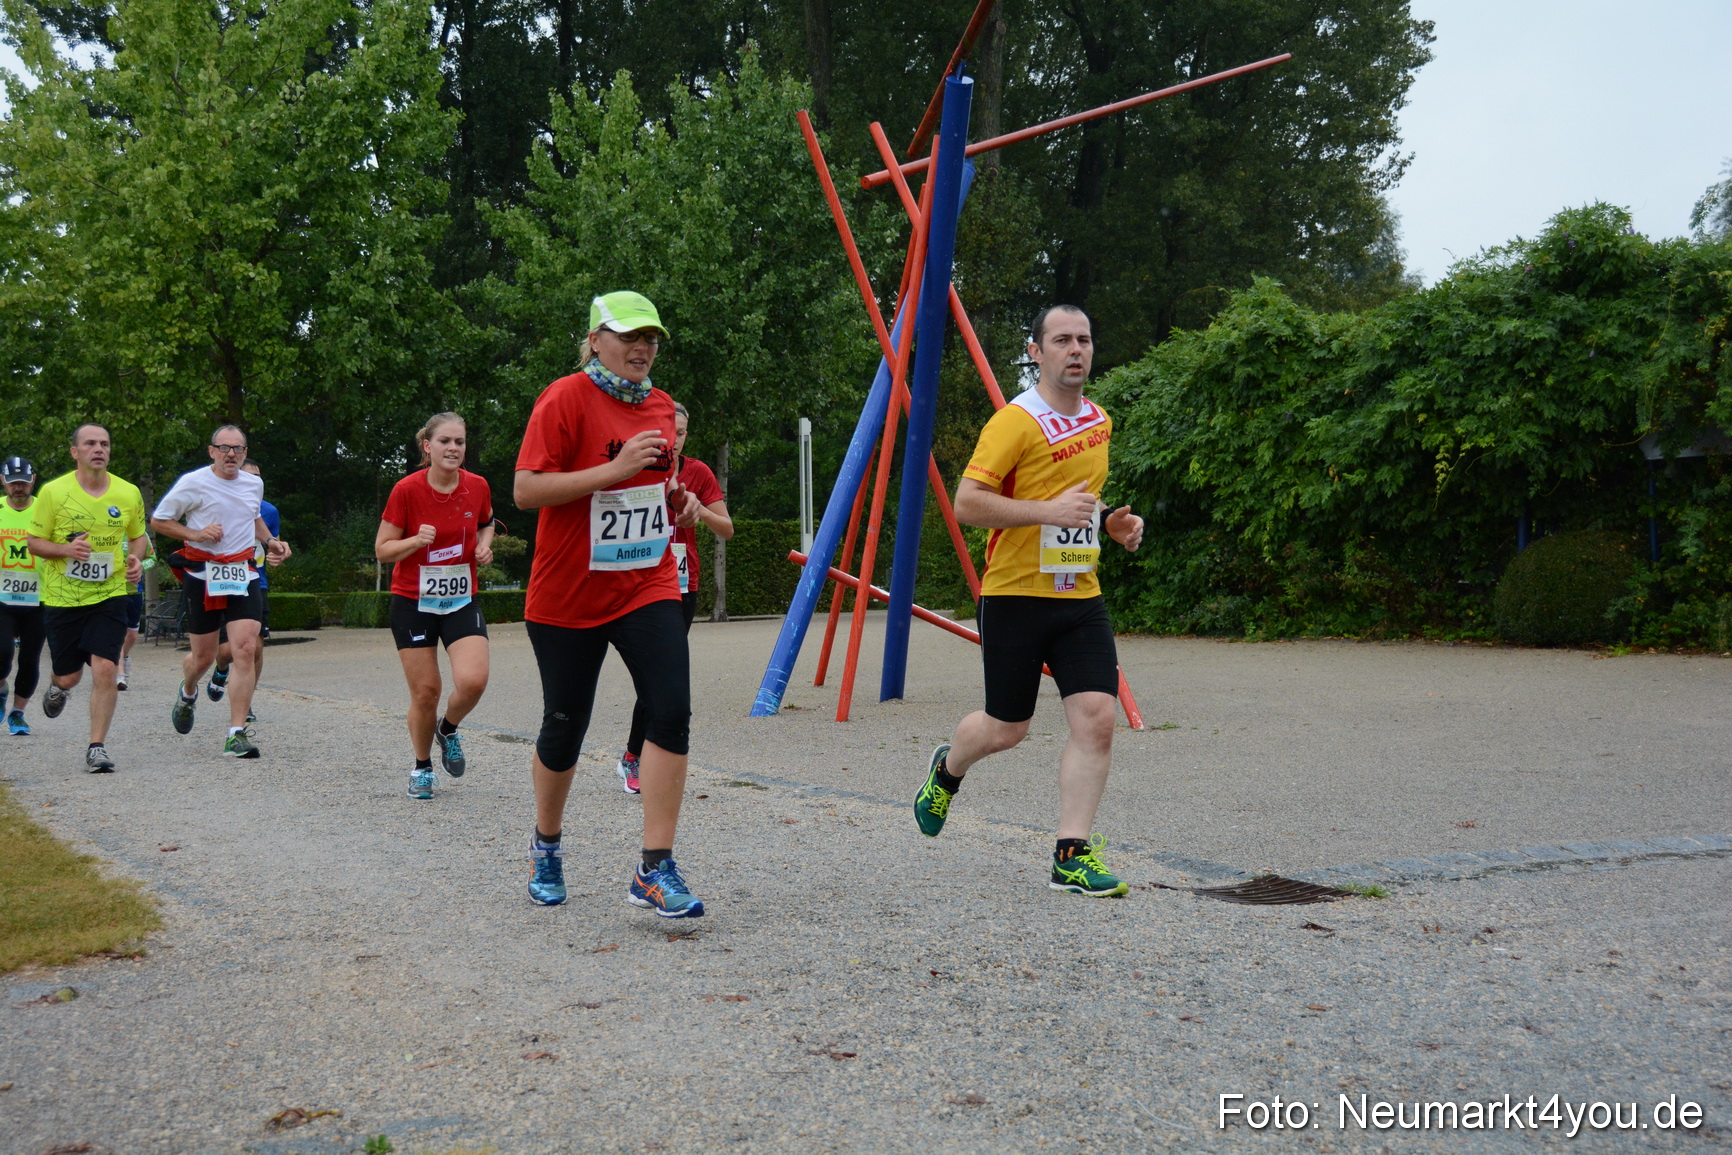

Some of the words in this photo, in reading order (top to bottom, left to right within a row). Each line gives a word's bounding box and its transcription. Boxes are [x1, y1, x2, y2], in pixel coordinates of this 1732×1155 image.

[1052, 440, 1086, 463] MAX
[601, 505, 665, 540] 2774
[1, 528, 29, 536] Müll
[1056, 519, 1094, 545] 326
[9, 545, 28, 560] M
[438, 550, 454, 558] DEHN
[616, 547, 652, 560] Andrea
[1061, 551, 1092, 563] Scherer
[71, 560, 108, 580] 2891
[211, 565, 247, 582] 2699
[2, 578, 38, 593] 2804
[426, 576, 469, 597] 2599
[438, 600, 454, 609] Anja
